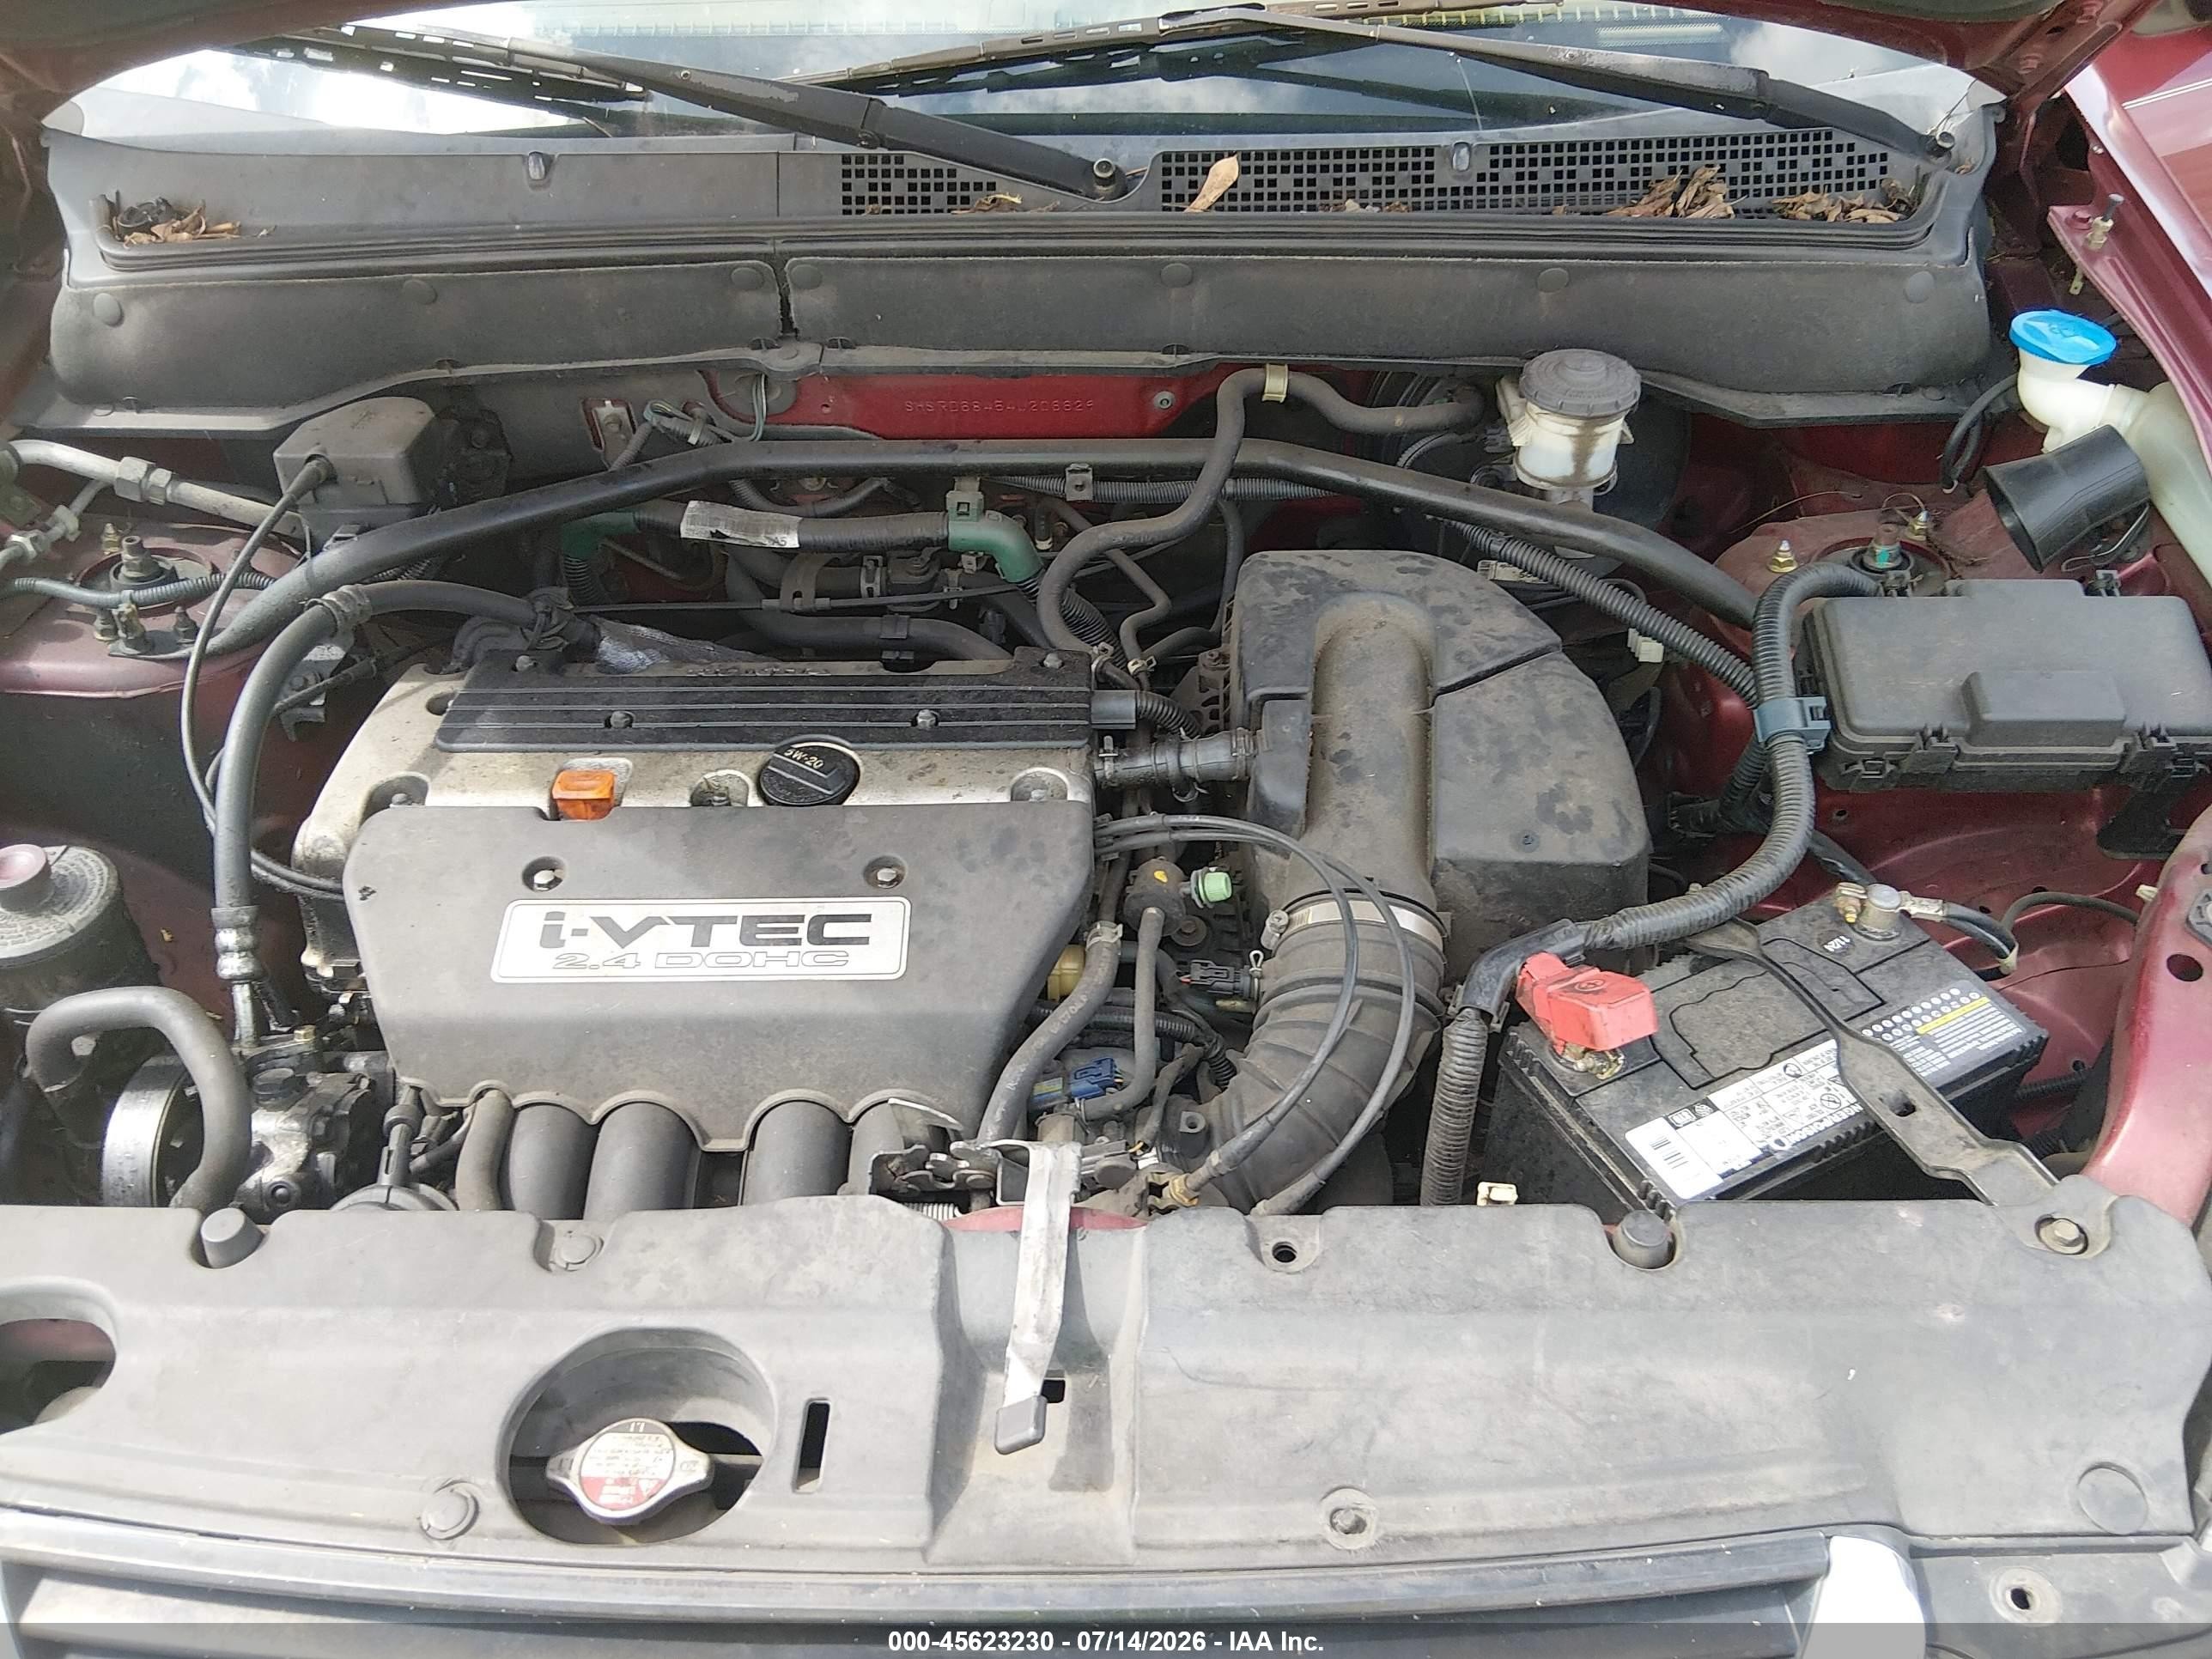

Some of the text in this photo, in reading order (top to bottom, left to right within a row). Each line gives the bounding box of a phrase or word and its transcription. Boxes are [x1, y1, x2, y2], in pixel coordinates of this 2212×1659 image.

[539, 910, 872, 949] i-VTEC
[552, 950, 849, 970] 2.4 DOHC
